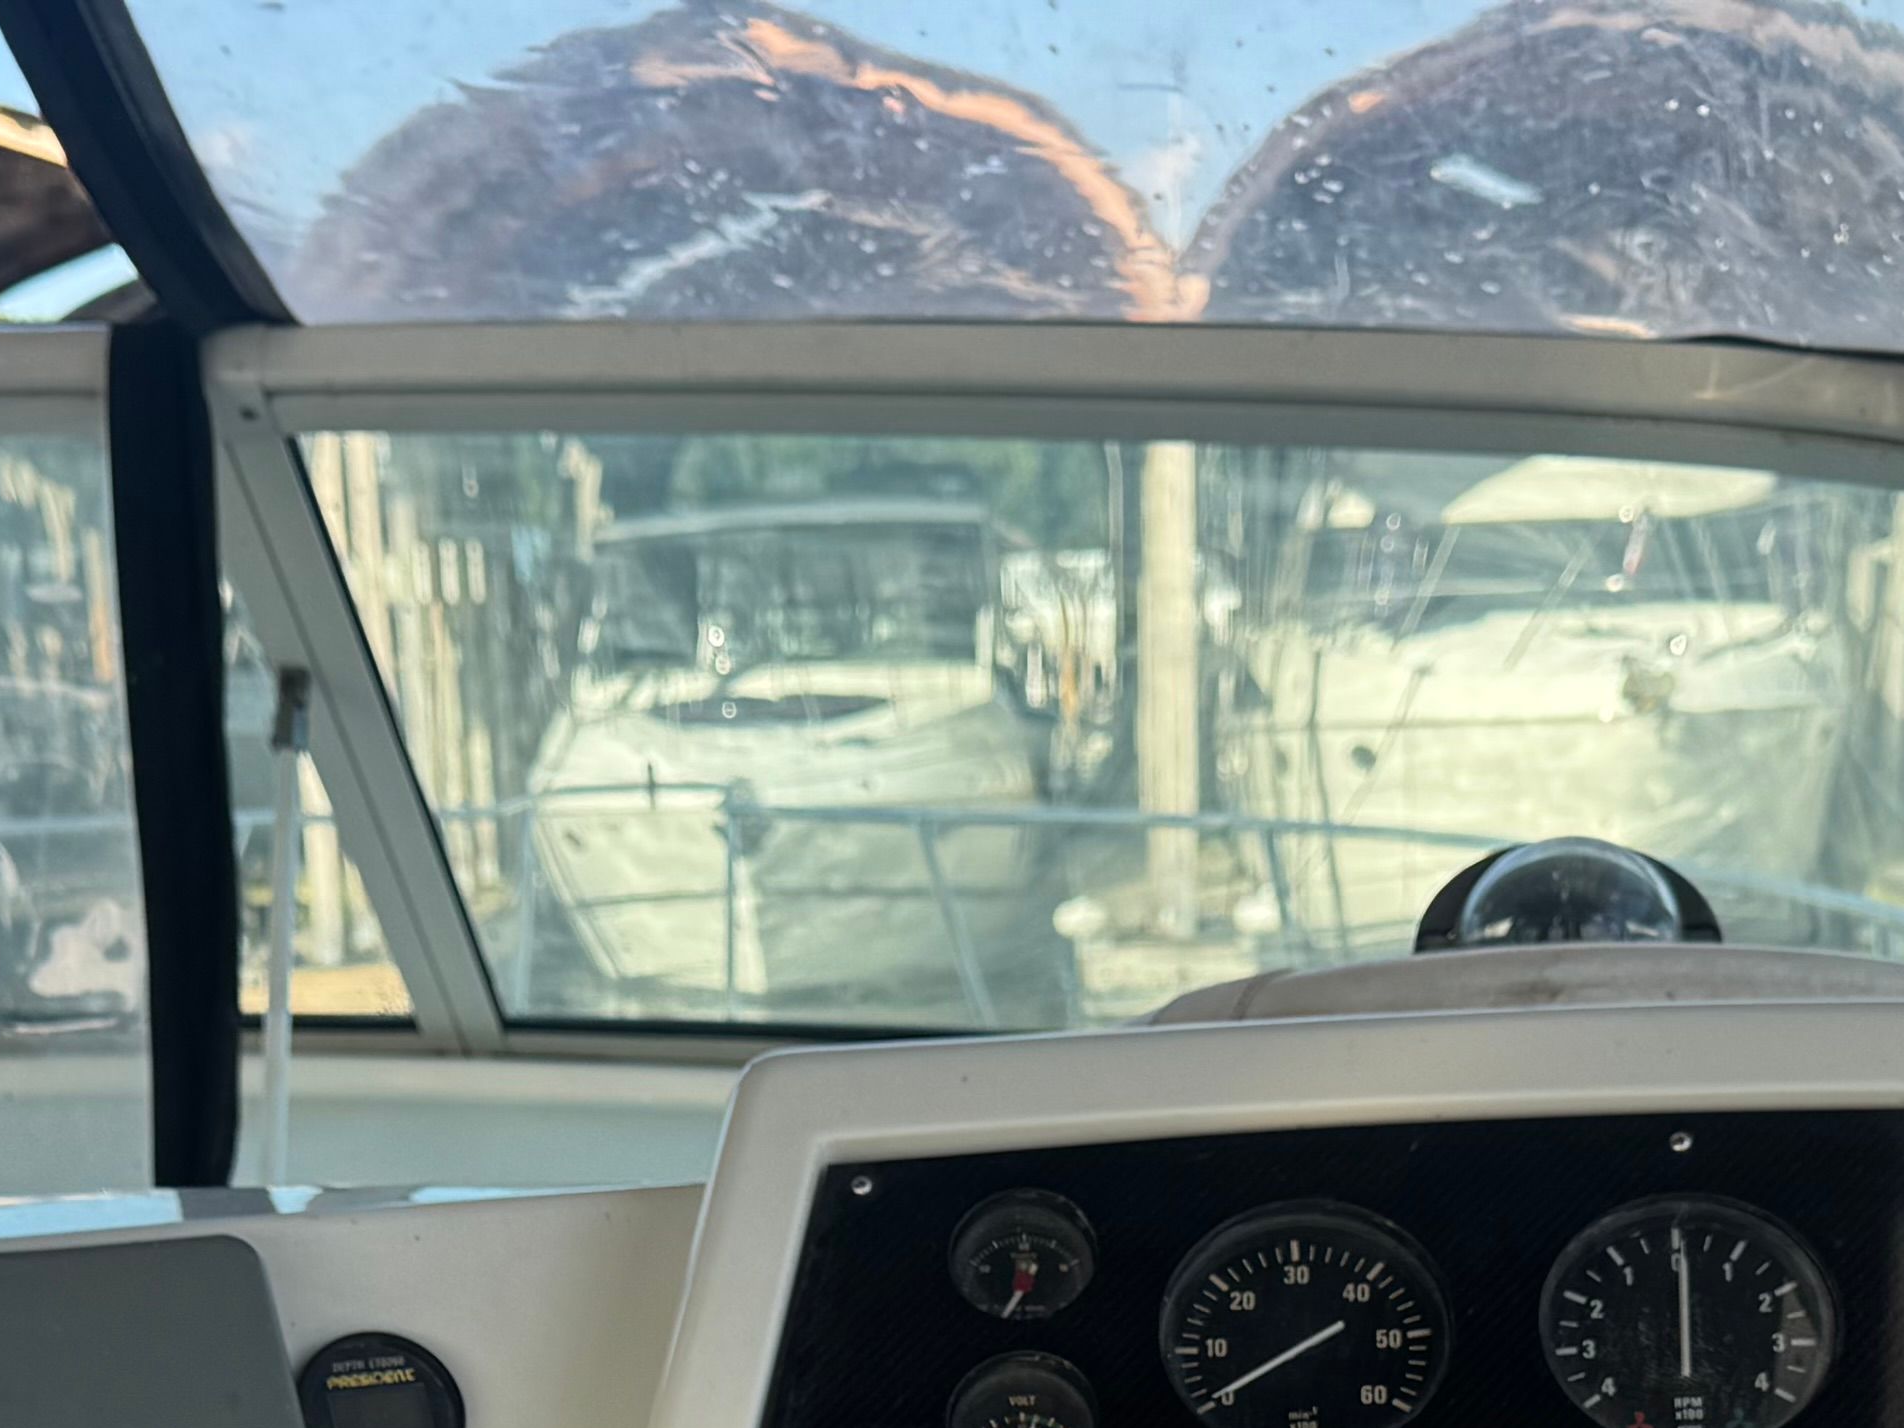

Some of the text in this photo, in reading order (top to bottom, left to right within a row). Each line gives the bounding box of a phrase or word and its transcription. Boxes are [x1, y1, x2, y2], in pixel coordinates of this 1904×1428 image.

[1283, 1265, 1310, 1285] 30
[1623, 1266, 1634, 1286] 1
[1722, 1262, 1733, 1282] 1
[1230, 1291, 1256, 1311] 20
[1343, 1283, 1370, 1302] 40
[1589, 1299, 1605, 1320] 2
[1758, 1293, 1773, 1313] 2
[1205, 1338, 1228, 1358] 10
[1375, 1329, 1402, 1349] 50
[1772, 1333, 1786, 1352] 3
[1581, 1340, 1596, 1359] 3
[1601, 1377, 1616, 1397] 4
[1754, 1372, 1770, 1392] 4
[1360, 1385, 1387, 1405] 60
[1673, 1396, 1703, 1409] RPM
